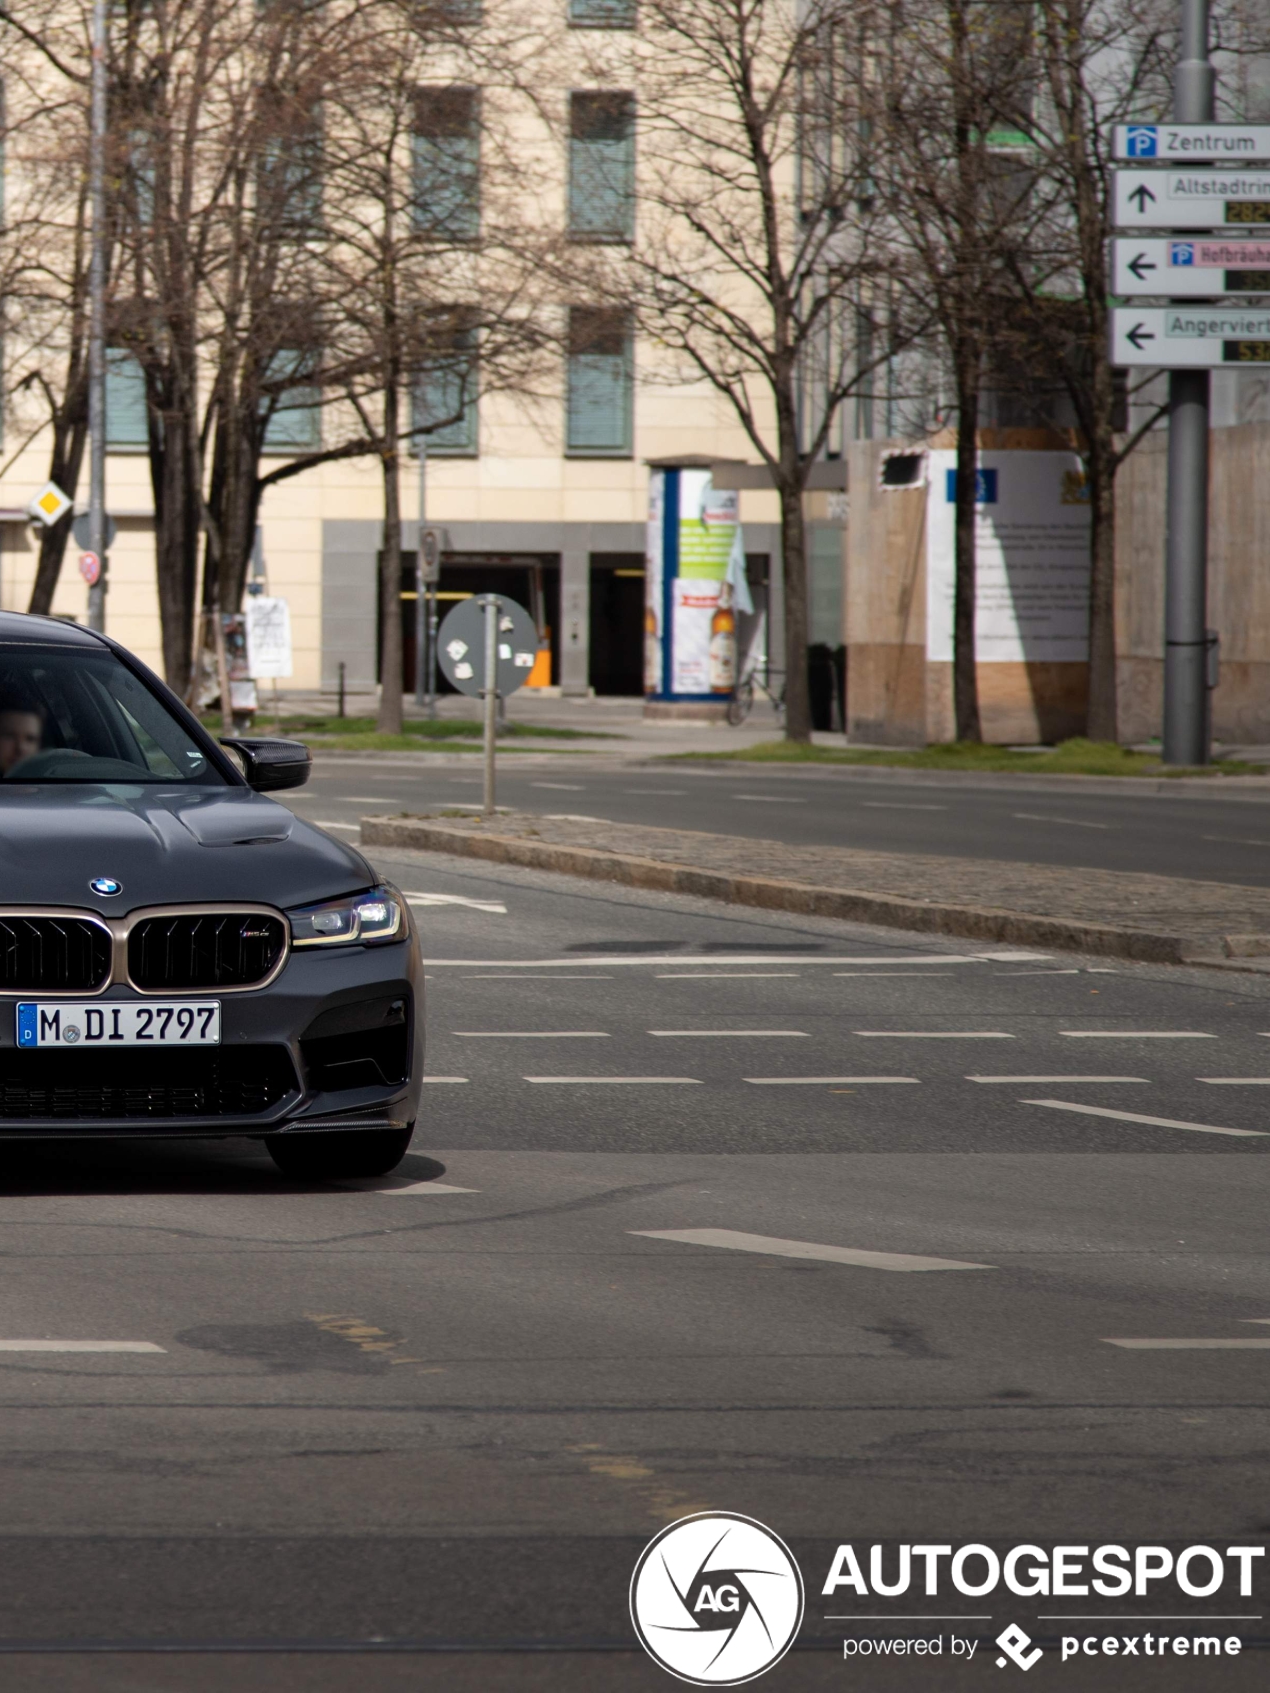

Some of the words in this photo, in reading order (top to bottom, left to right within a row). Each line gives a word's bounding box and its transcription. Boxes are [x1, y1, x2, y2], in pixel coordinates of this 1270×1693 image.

[1167, 133, 1255, 151] Zentrum
[40, 1009, 61, 1041] M
[85, 1009, 125, 1040] DI
[136, 1008, 215, 1040] 2797
